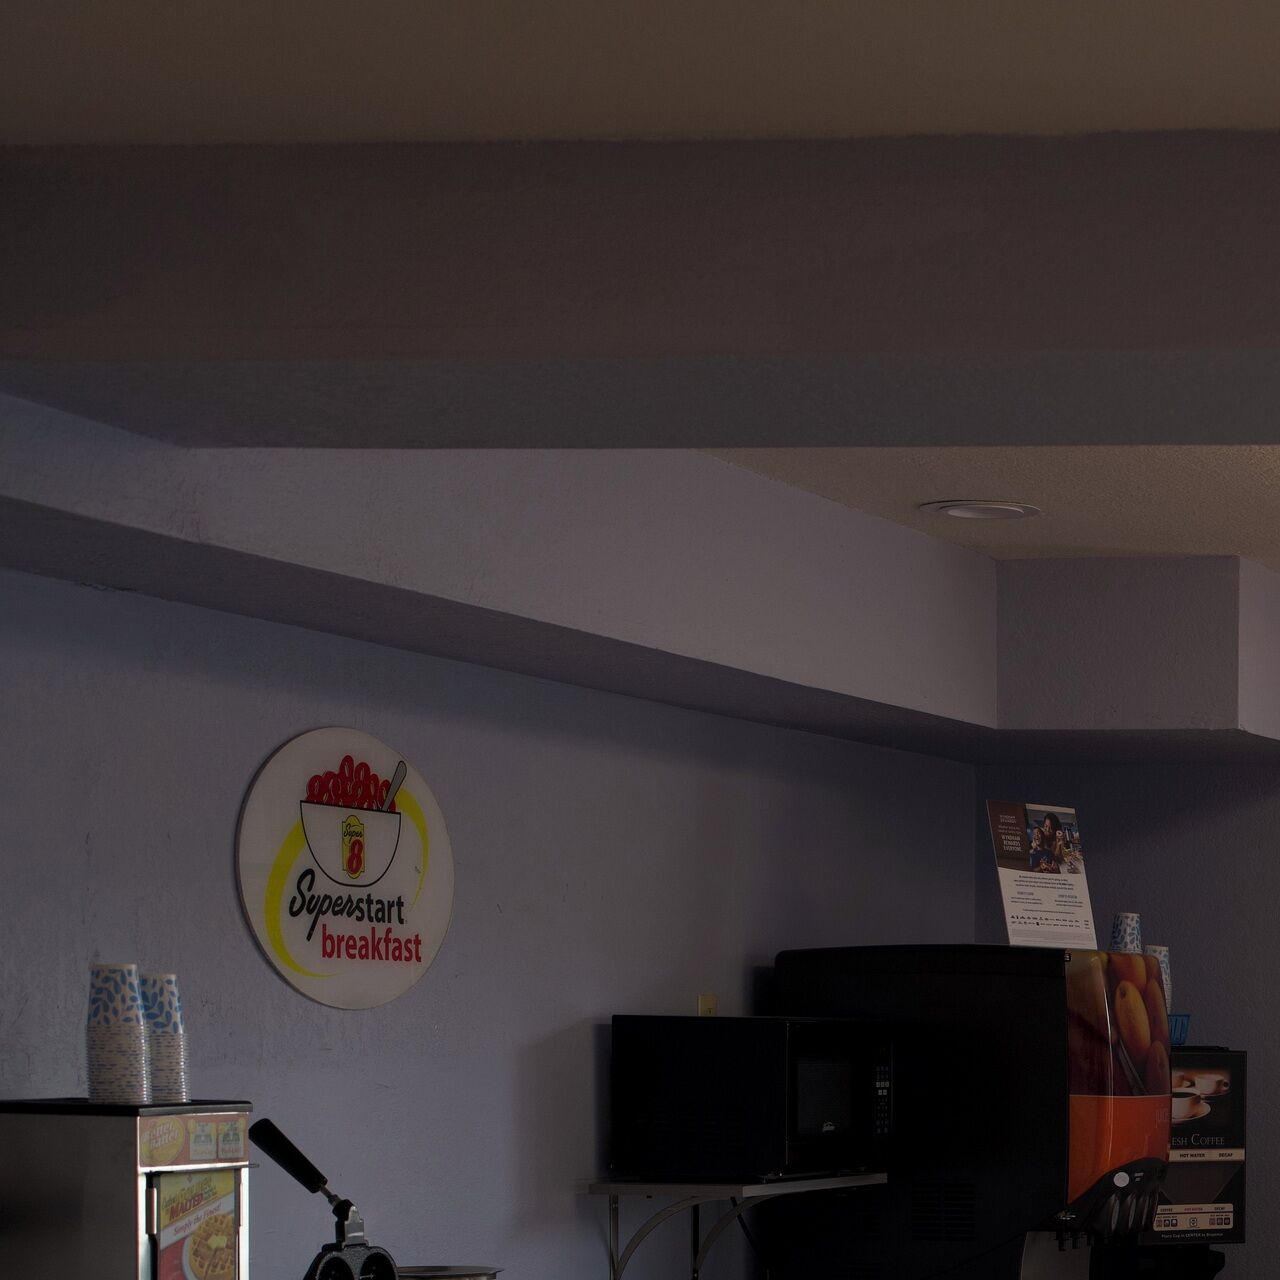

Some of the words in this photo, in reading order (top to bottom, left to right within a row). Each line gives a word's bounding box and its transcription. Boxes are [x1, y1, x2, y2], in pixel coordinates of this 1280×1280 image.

[343, 822, 364, 846] Super
[347, 839, 364, 875] 8
[288, 868, 405, 941] Superstart
[322, 924, 422, 962] breakfast
[1172, 1137, 1188, 1146] ESH
[1190, 1134, 1225, 1146] COFFEE
